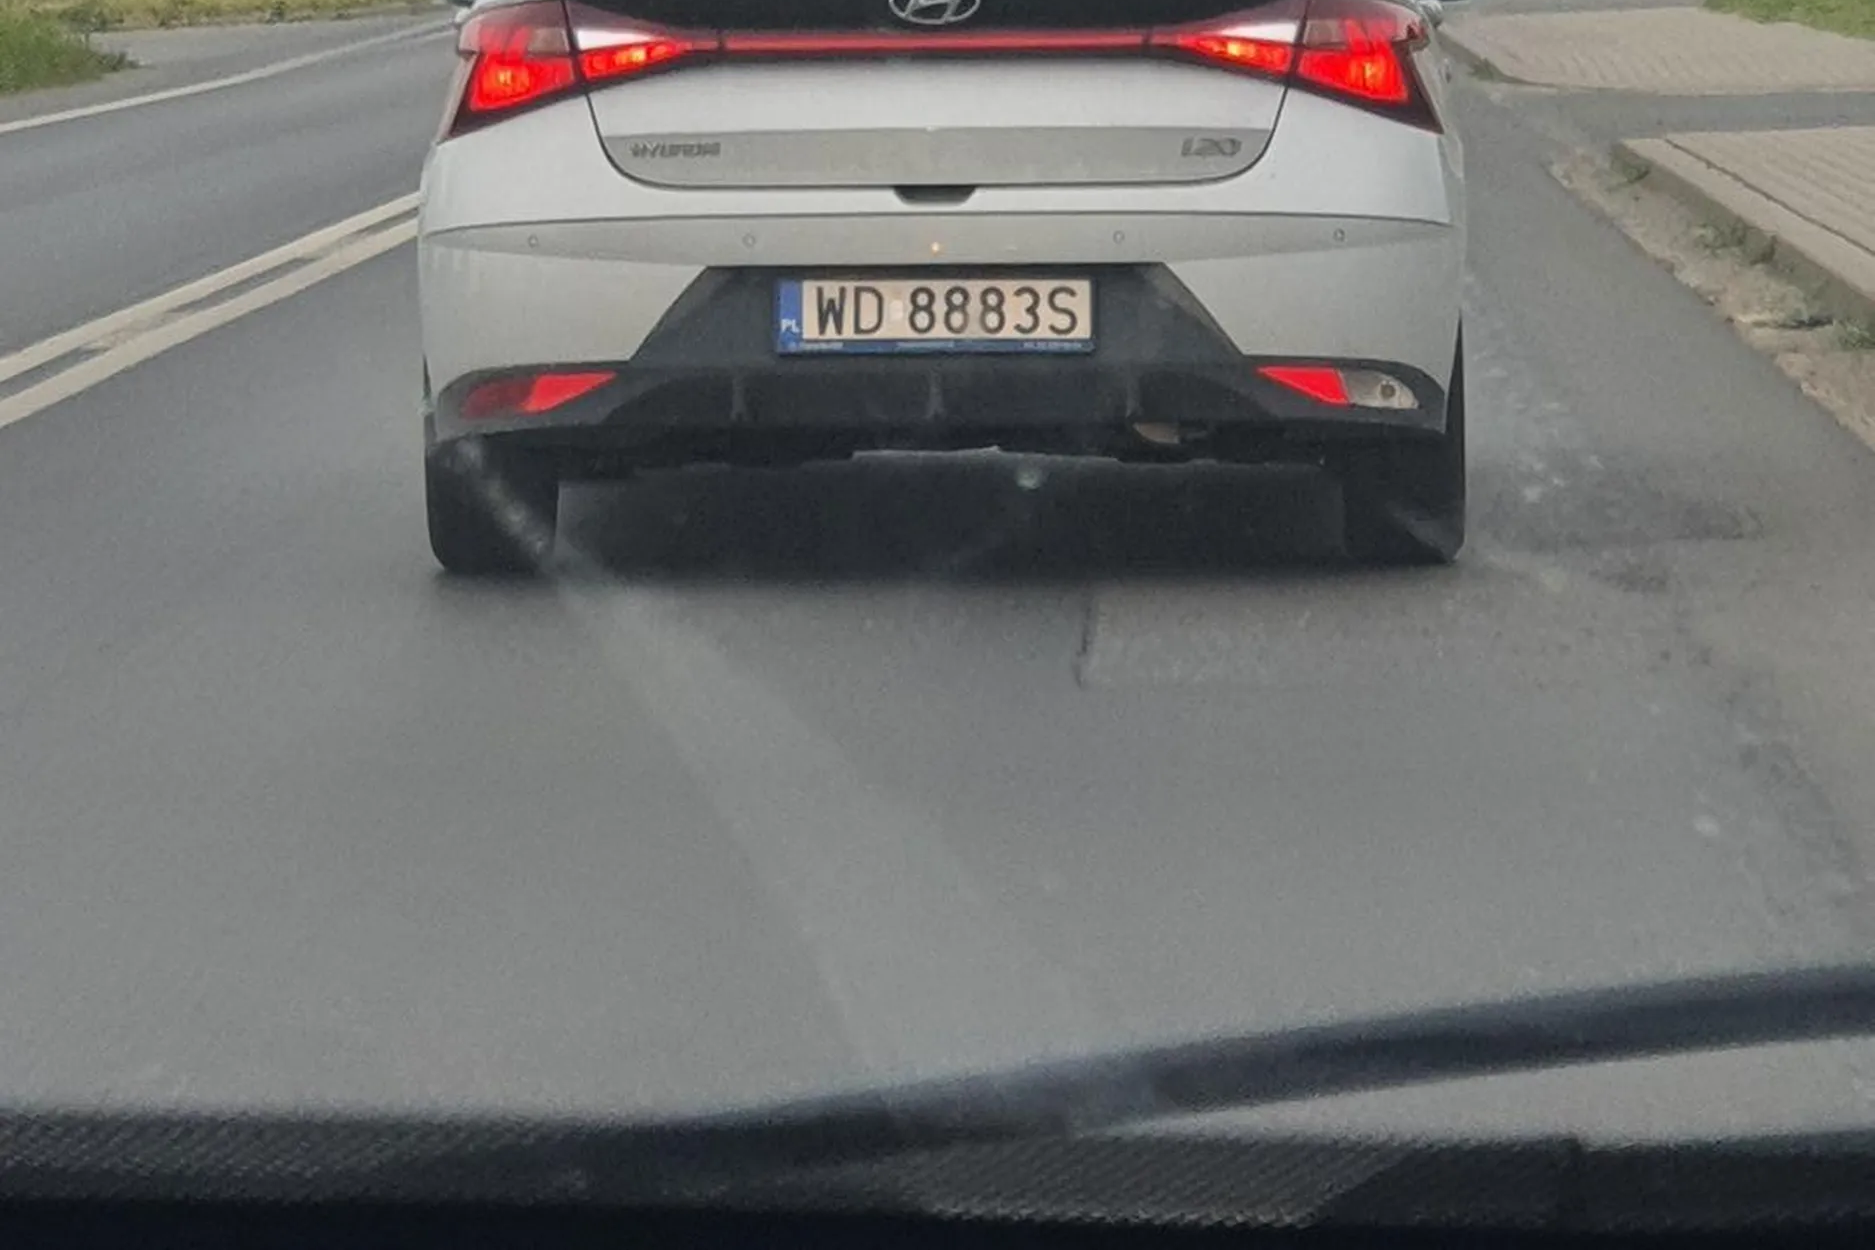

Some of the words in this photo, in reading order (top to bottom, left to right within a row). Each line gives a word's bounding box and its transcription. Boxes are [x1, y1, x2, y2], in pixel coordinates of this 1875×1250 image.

[781, 318, 800, 333] PL
[816, 286, 885, 336] WD
[908, 286, 1078, 335] 8883S
